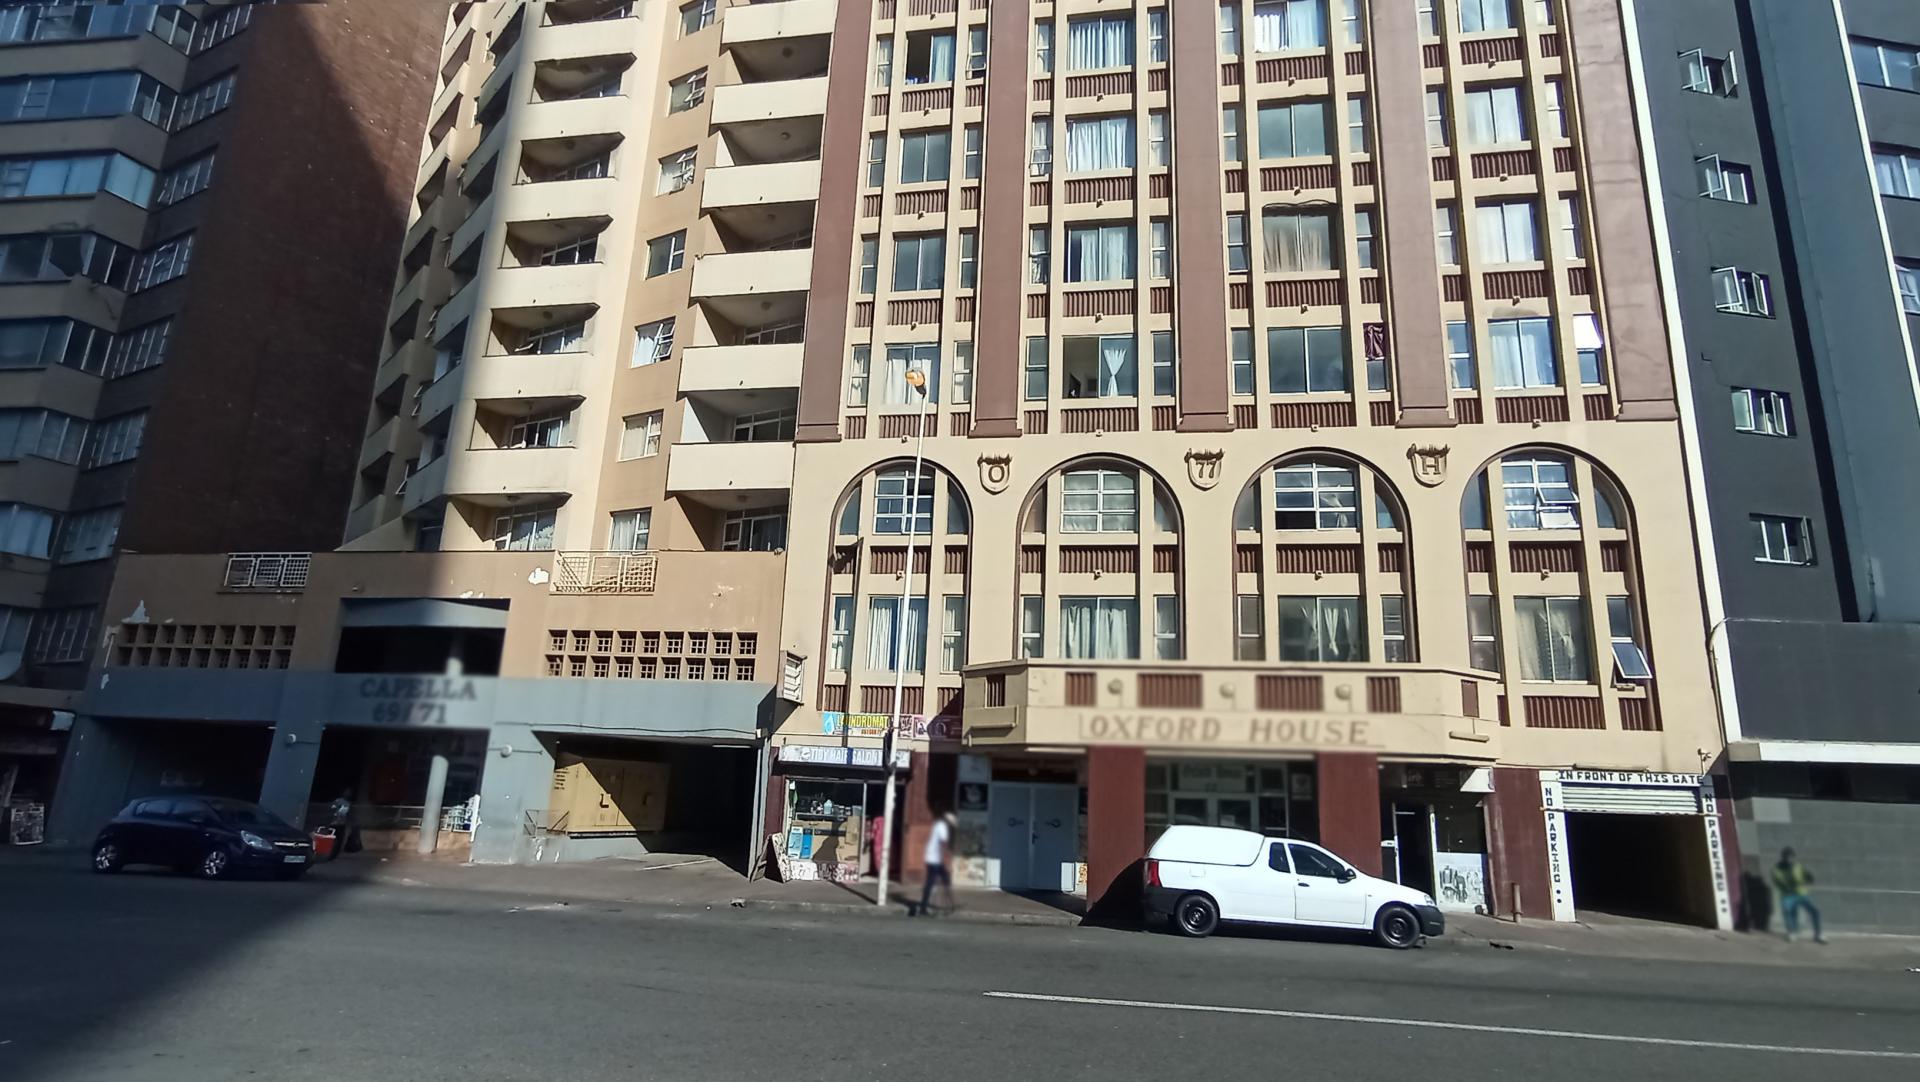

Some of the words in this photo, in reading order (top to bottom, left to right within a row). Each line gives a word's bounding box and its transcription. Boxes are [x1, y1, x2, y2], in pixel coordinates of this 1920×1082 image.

[988, 465, 1005, 483] O
[1195, 460, 1217, 479] 77
[1421, 456, 1441, 475] H
[361, 678, 477, 700] CAPELLA
[1089, 714, 1222, 742] OXFORD
[1250, 718, 1370, 745] HOUSE
[1558, 770, 1573, 780] IN
[1576, 771, 1614, 782] FRONT
[1618, 773, 1632, 782] OF
[1638, 773, 1669, 783] THIS
[1672, 774, 1703, 785] GATE
[1545, 787, 1553, 807] NO
[1704, 793, 1714, 813] NO
[1548, 812, 1561, 883] PARKING
[1708, 819, 1725, 891] PARKING
